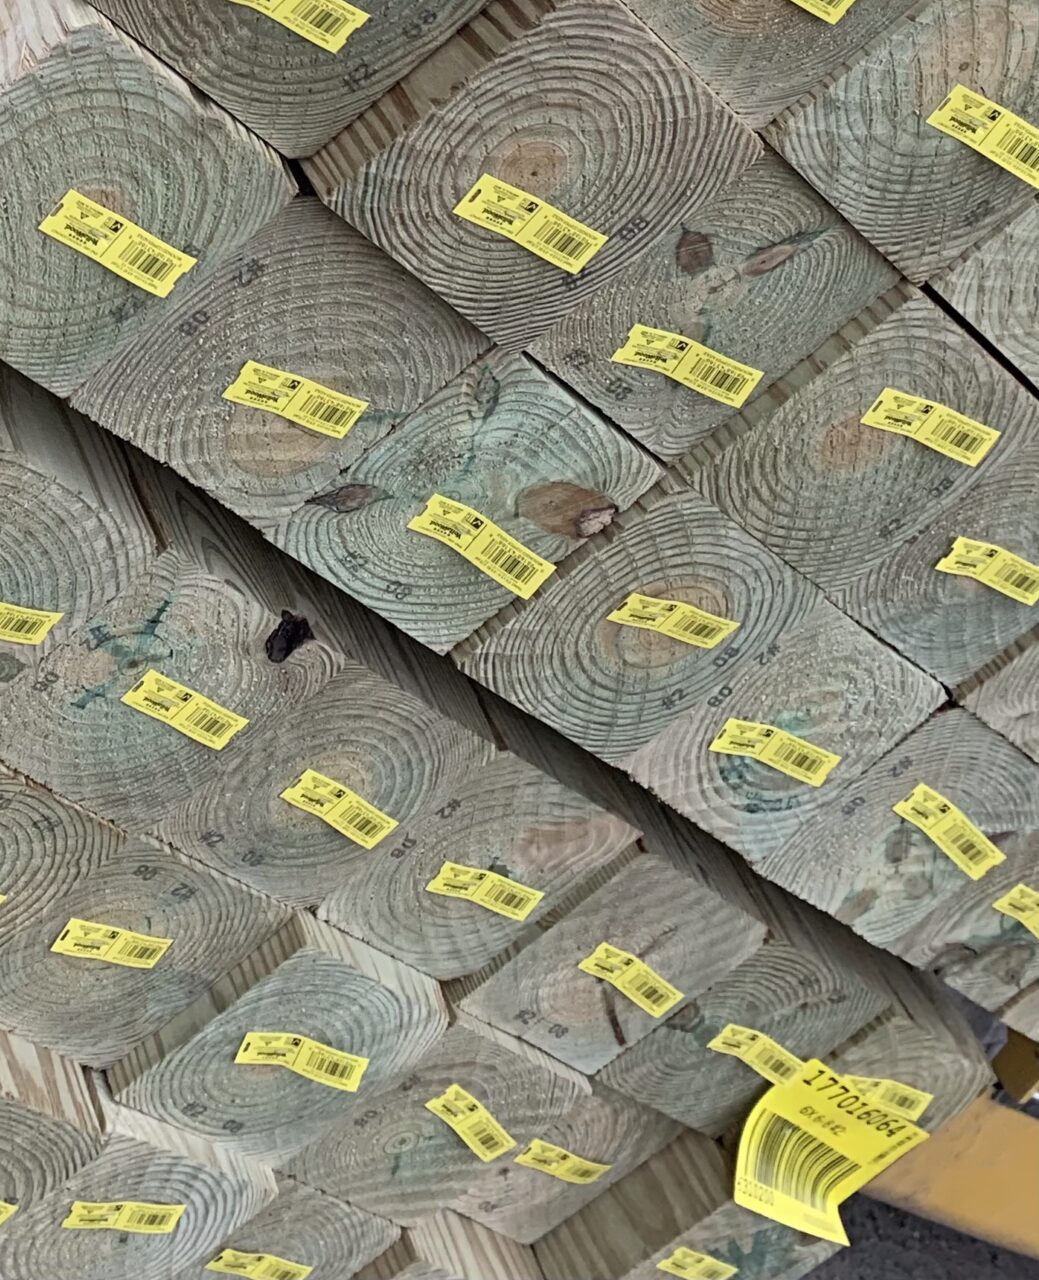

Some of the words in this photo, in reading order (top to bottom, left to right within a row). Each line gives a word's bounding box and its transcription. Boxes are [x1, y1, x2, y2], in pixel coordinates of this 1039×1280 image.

[62, 222, 99, 247] YellaWood
[753, 643, 781, 665] #2
[662, 687, 688, 710] #2
[707, 685, 733, 707] 08
[803, 1070, 907, 1137] 177016064
